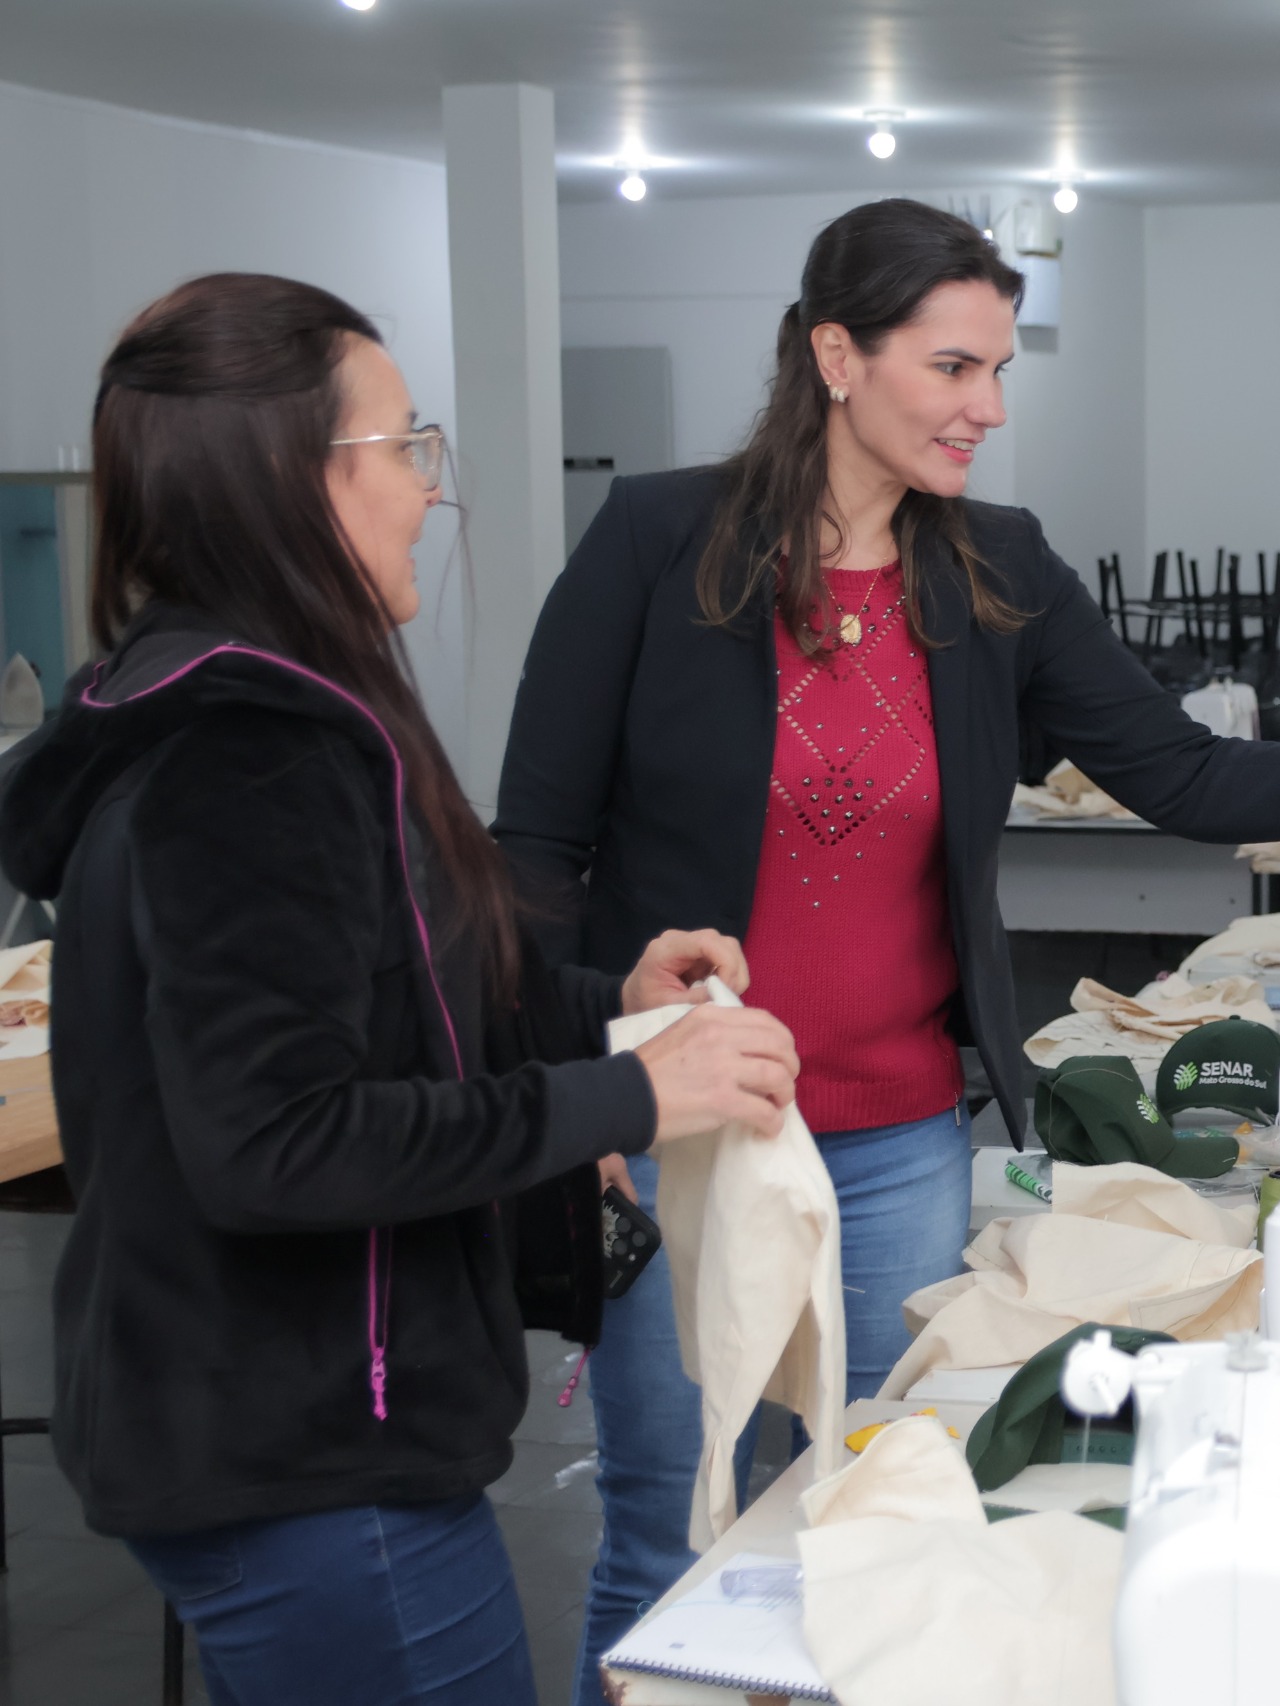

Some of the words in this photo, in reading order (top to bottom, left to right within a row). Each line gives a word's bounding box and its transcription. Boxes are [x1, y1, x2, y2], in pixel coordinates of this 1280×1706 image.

[1200, 1061, 1252, 1077] SENAR
[1218, 1077, 1244, 1085] Grosso
[1244, 1078, 1254, 1086] do
[1254, 1080, 1267, 1089] Sul
